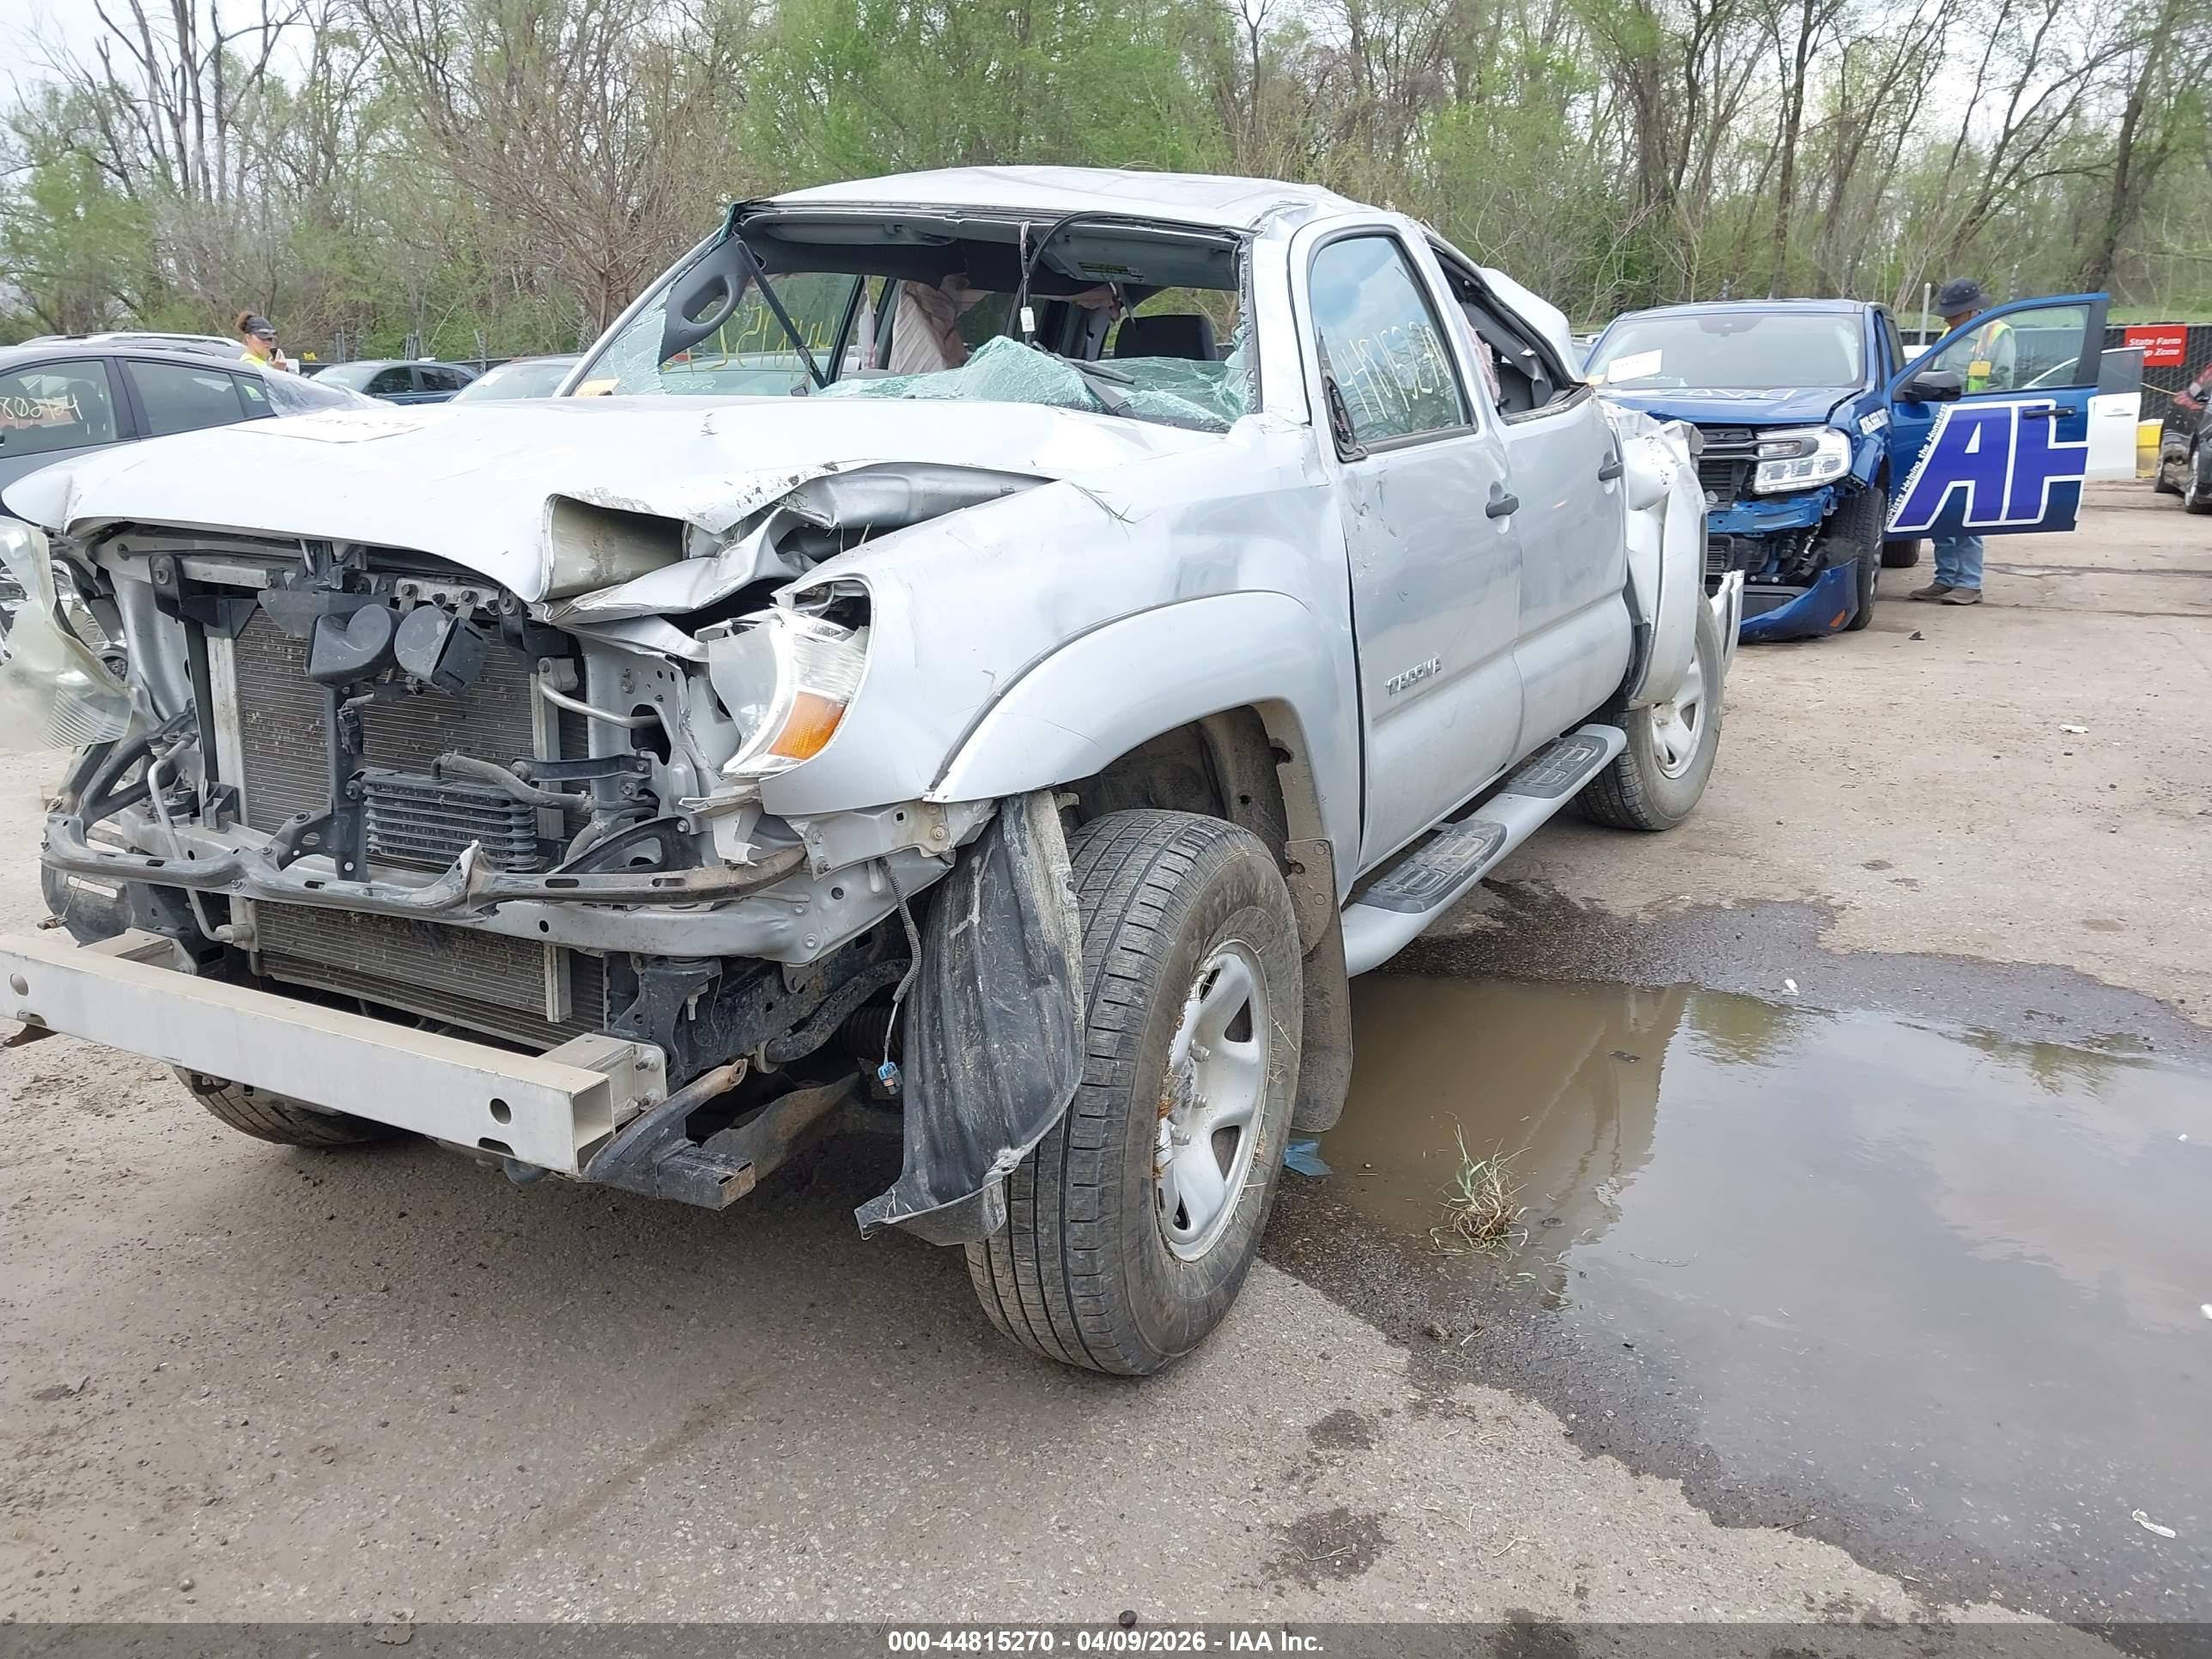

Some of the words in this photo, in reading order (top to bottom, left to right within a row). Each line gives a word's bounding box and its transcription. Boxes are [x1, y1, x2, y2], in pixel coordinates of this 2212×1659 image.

[2129, 337, 2154, 346] State
[2156, 337, 2182, 345] Farm
[2154, 348, 2180, 356] Zone
[1900, 460, 1922, 493] Helping
[1917, 443, 1929, 459] the
[1925, 404, 1948, 445] Homeless
